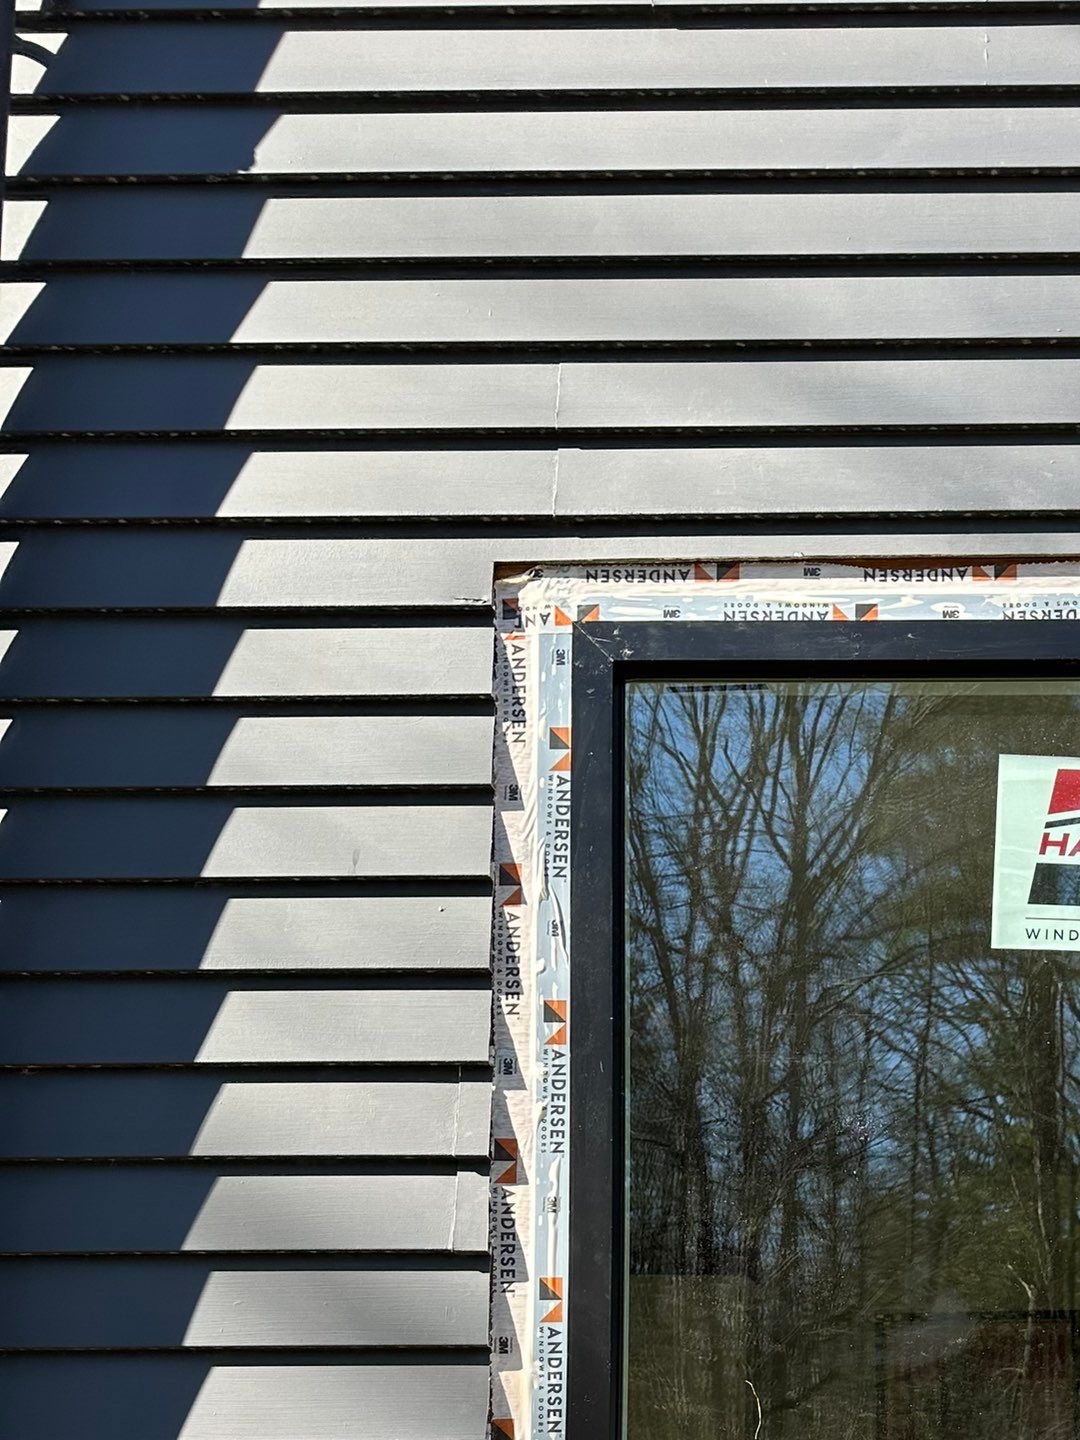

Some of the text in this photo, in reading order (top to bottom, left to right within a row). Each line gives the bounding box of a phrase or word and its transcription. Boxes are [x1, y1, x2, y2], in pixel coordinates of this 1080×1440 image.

[586, 569, 691, 582] ANDERSEN
[803, 568, 821, 577] 3M
[863, 568, 968, 582] ANDERSEN
[663, 608, 680, 618] 3M
[724, 610, 829, 621] ANDERSEN
[942, 609, 960, 618] 3M
[556, 648, 566, 666] 3M
[511, 644, 527, 743] ANDERSEN
[508, 784, 518, 800] 3M
[552, 775, 570, 879] ANDERSEN
[505, 912, 521, 1016] ANDERSEN
[503, 1058, 513, 1075] 3M
[550, 1049, 567, 1154] ANDERSEN
[500, 1187, 516, 1295] ANDERSEN
[498, 1336, 509, 1354] 3M
[546, 1327, 563, 1434] ANDERSEN
